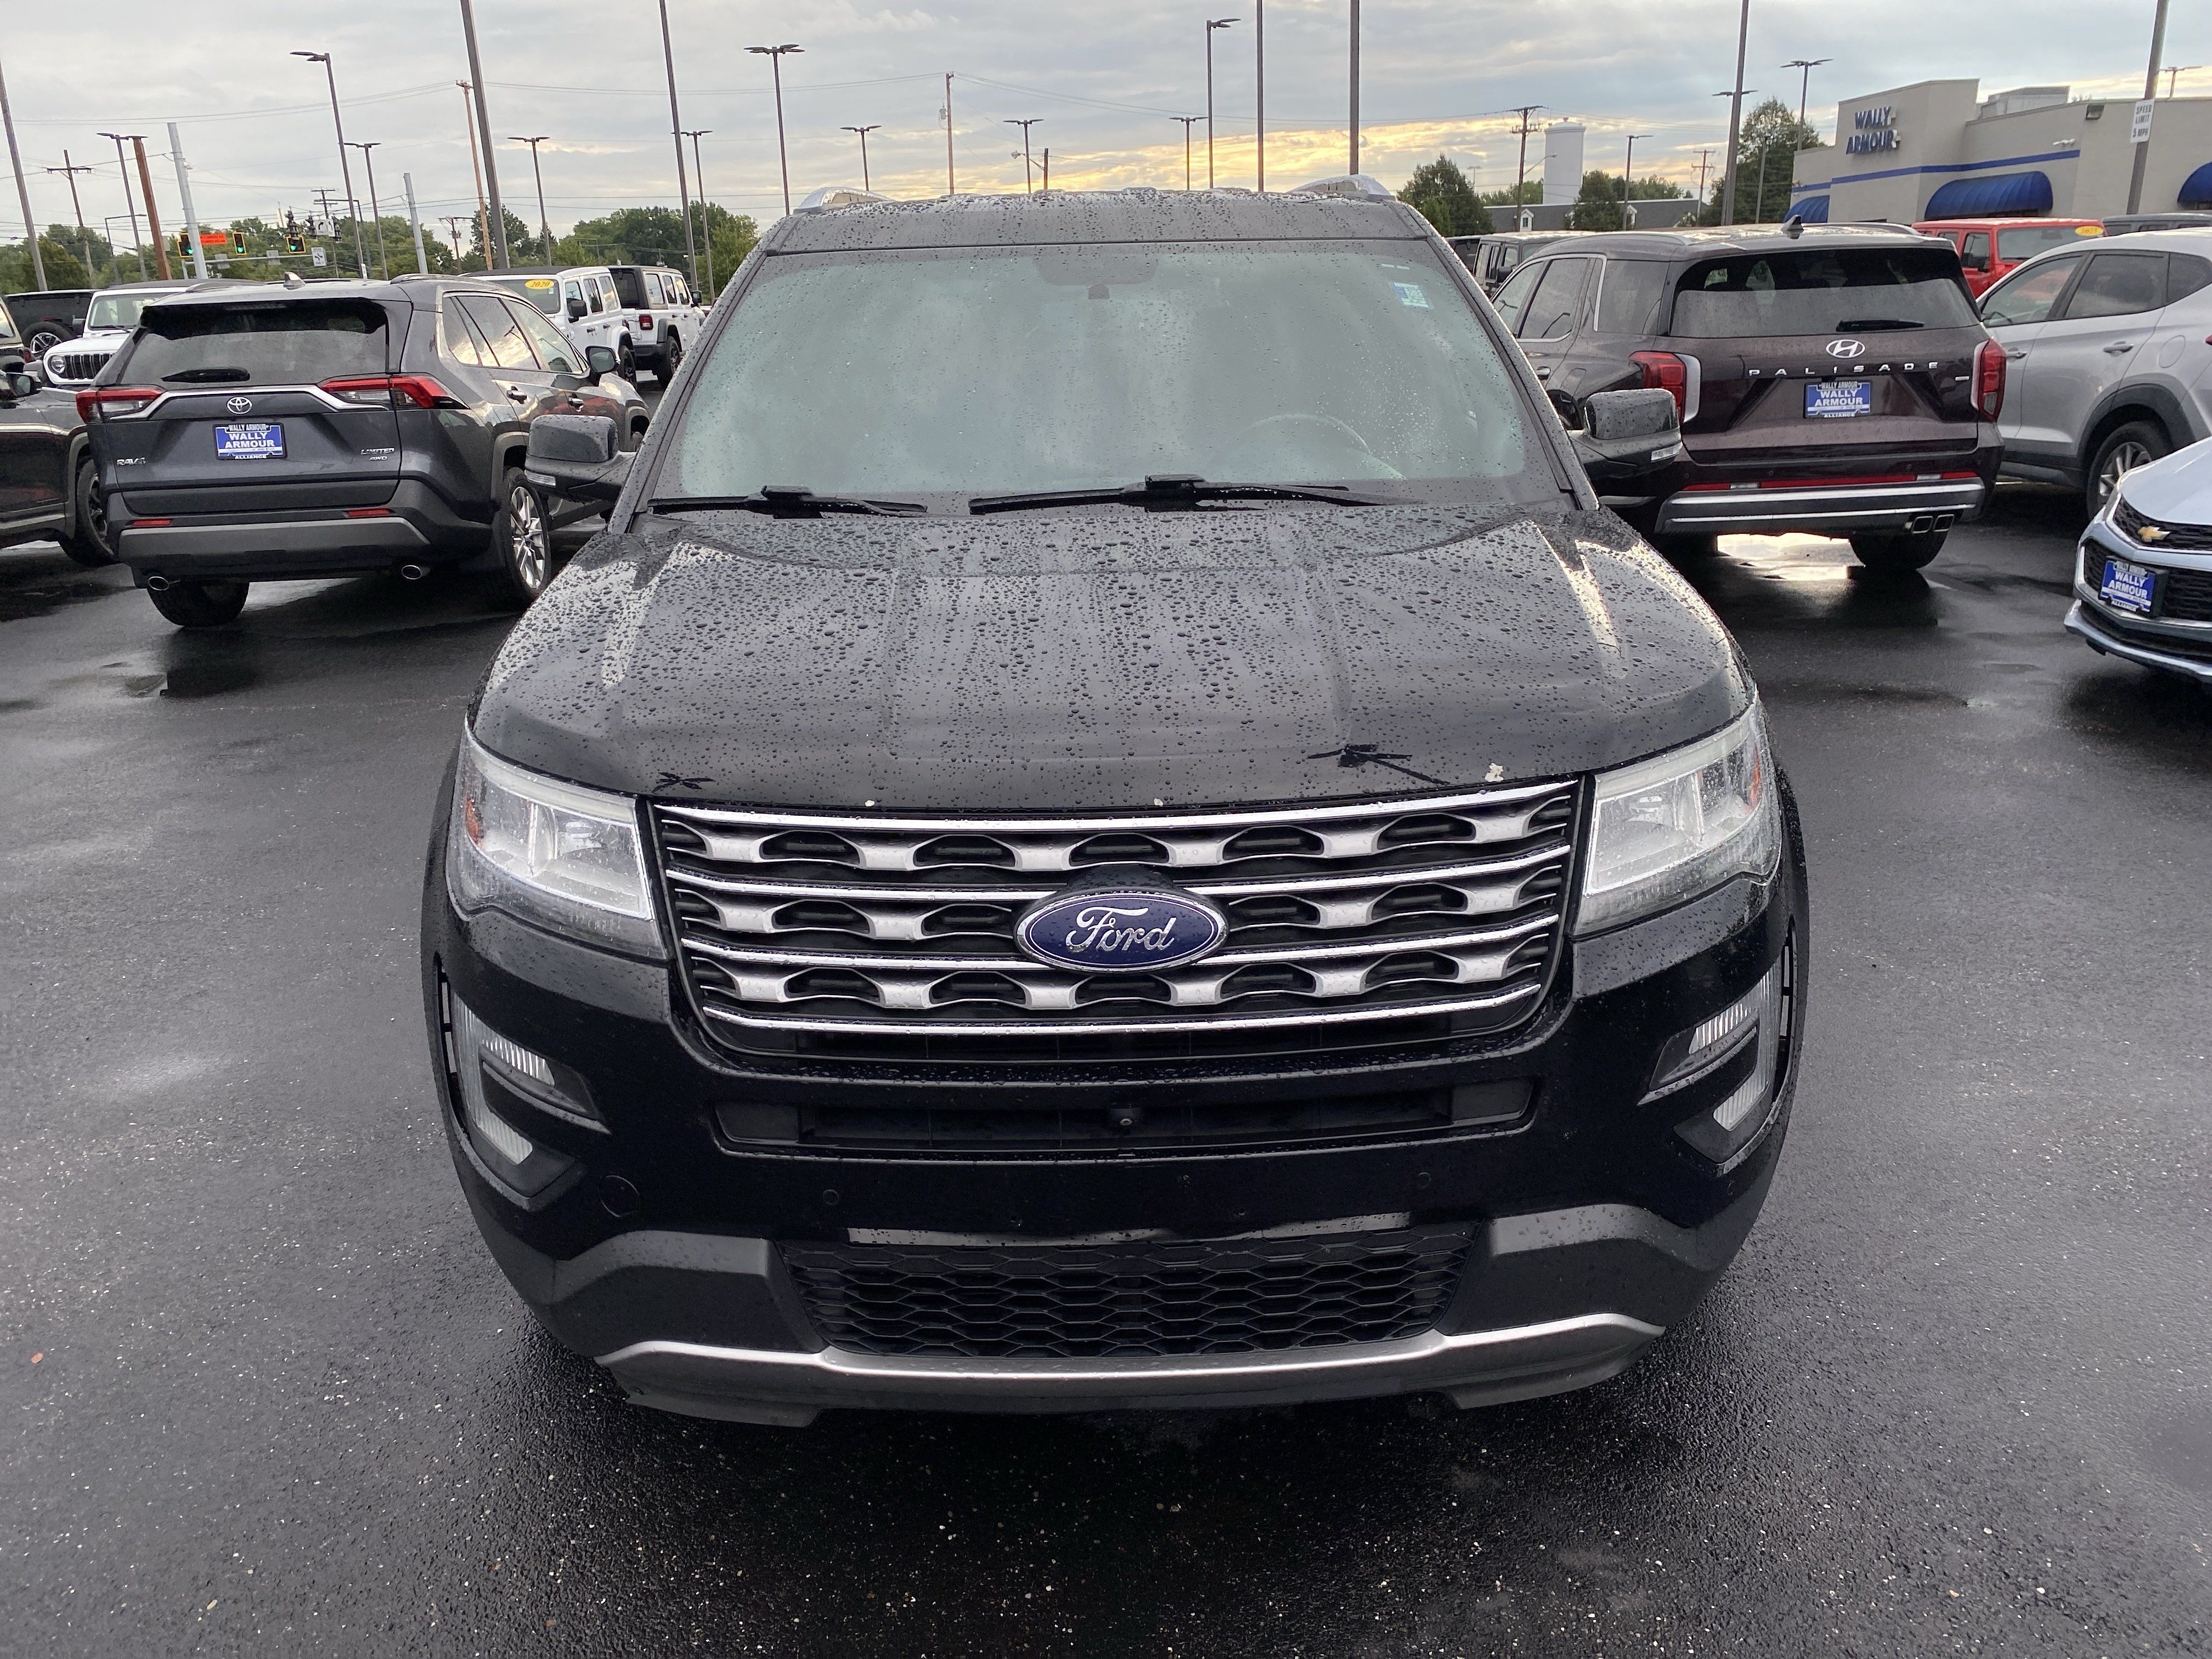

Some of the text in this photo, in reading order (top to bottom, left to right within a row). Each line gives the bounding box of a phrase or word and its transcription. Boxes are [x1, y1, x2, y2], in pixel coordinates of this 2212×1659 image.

[2136, 105, 2152, 114] SPEED
[1855, 106, 1892, 129] WALLY
[2135, 114, 2150, 124] LIMIT
[2132, 127, 2149, 138] 5 MPH
[1846, 129, 1897, 155] ARMOUR
[1748, 362, 1938, 376] PALISADE
[1820, 389, 1858, 398] WALLY
[1814, 397, 1863, 407] ARMOUR
[229, 432, 267, 440] WALLY
[224, 439, 275, 449] ARMOUR
[2115, 571, 2146, 588] WALLY
[2108, 579, 2148, 600] ARMOUR
[1065, 906, 1177, 953] Ford
